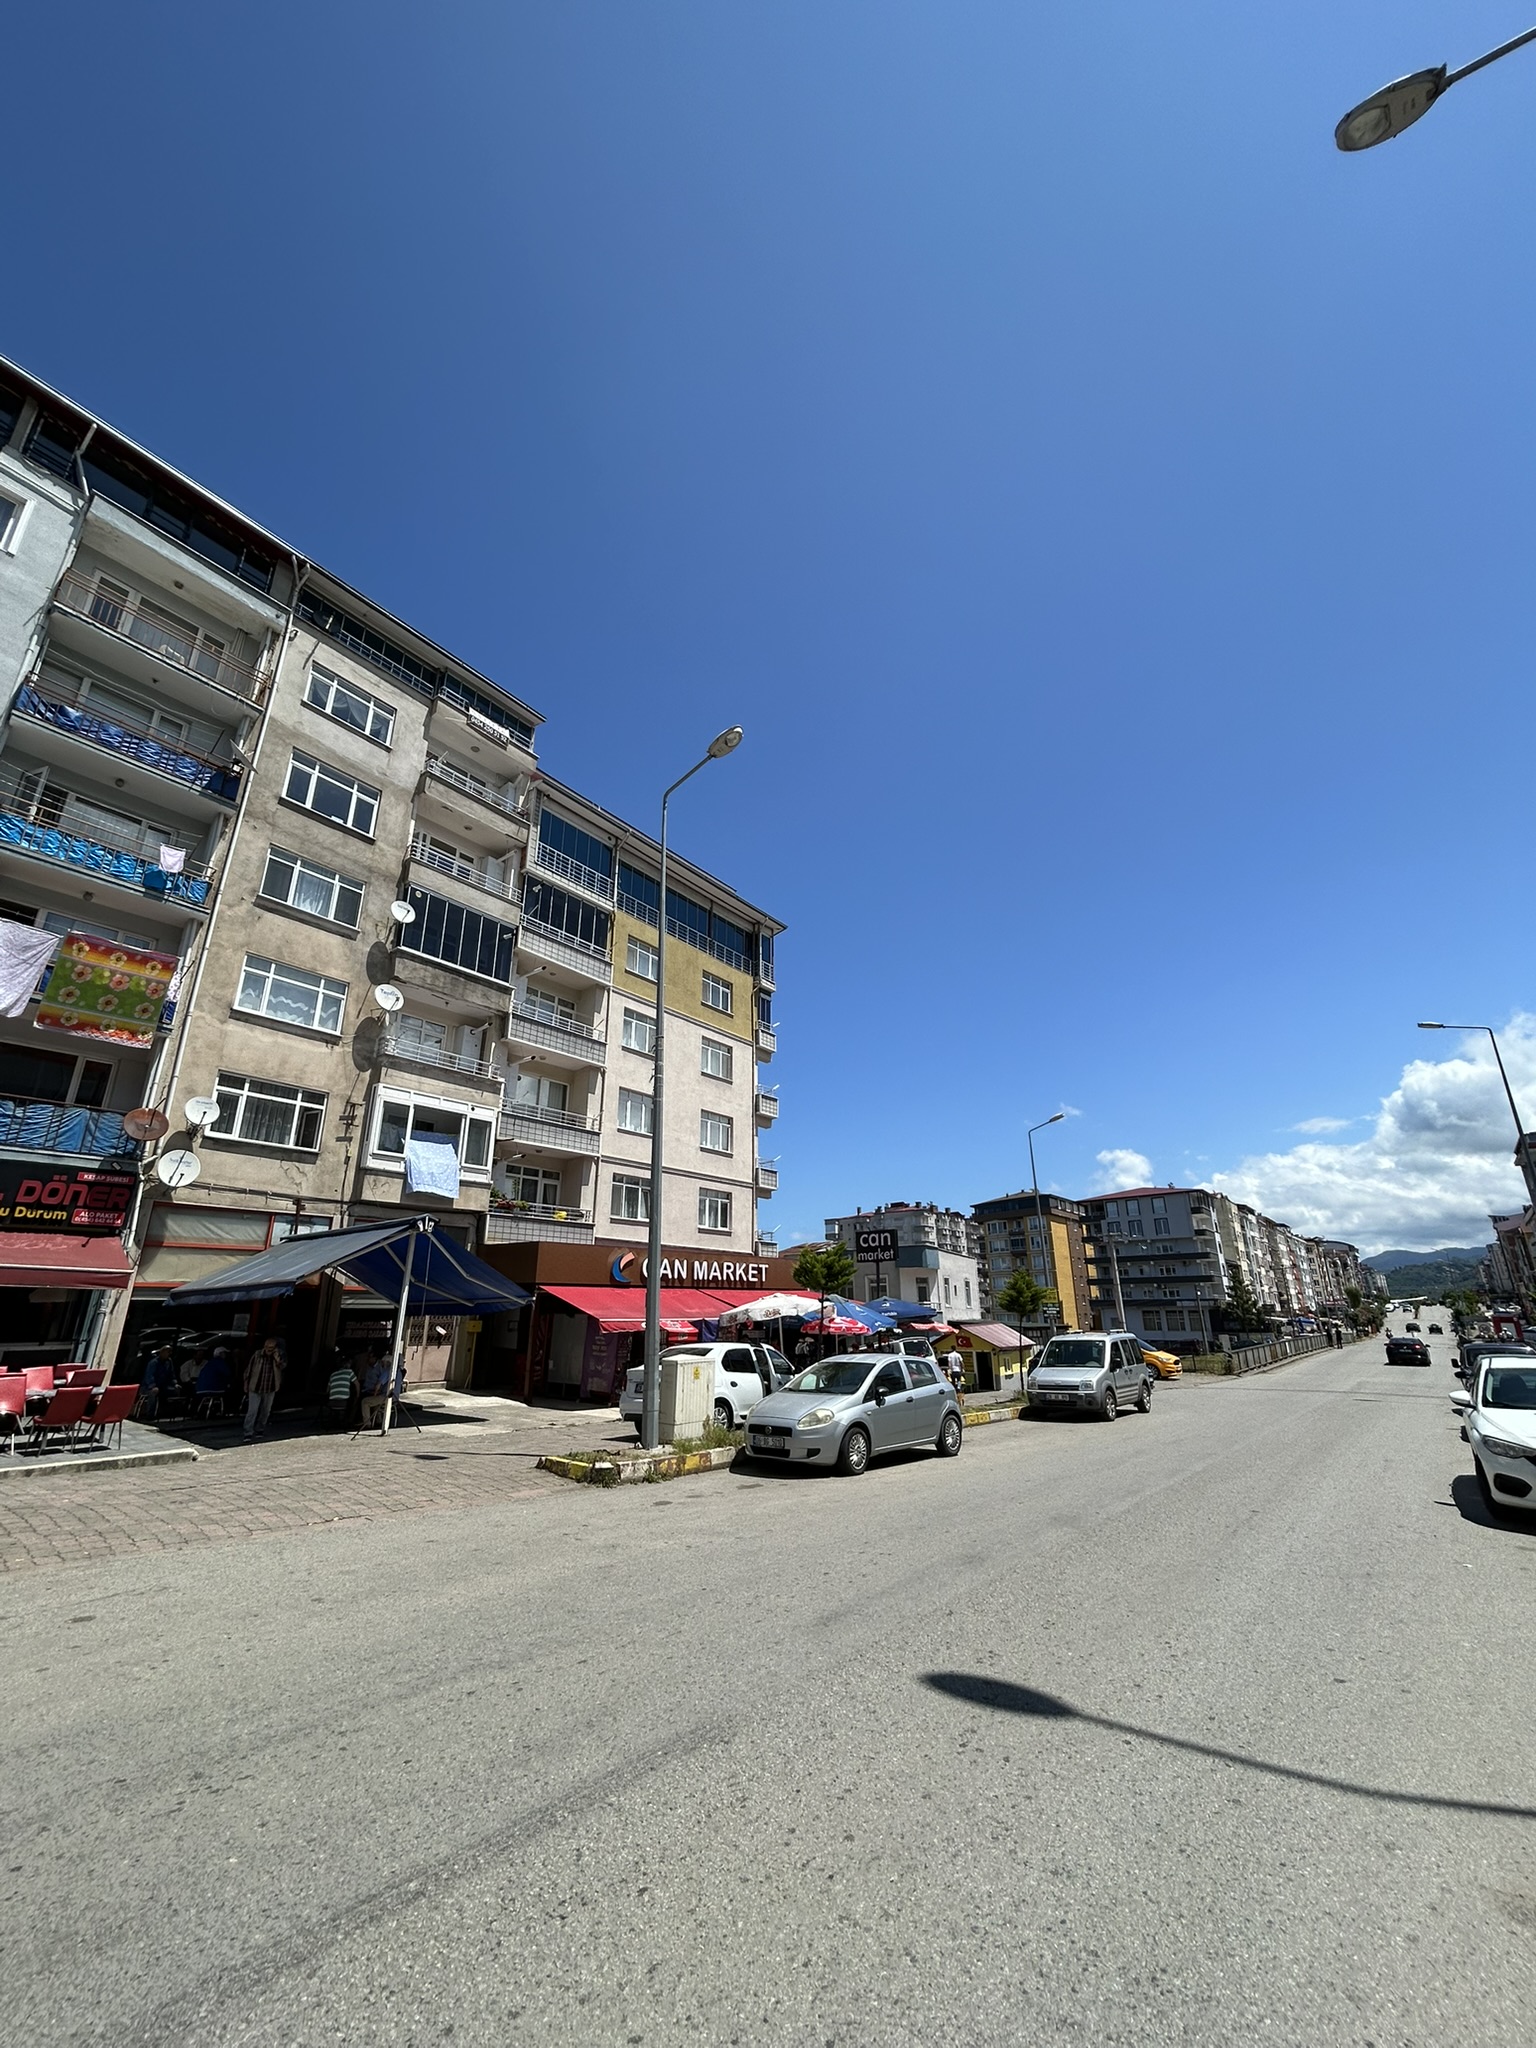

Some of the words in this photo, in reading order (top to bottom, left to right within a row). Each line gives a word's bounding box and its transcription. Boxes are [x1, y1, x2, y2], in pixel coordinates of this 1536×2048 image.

[860, 1232, 891, 1247] can
[858, 1247, 894, 1261] market
[693, 1260, 769, 1282] MARKET
